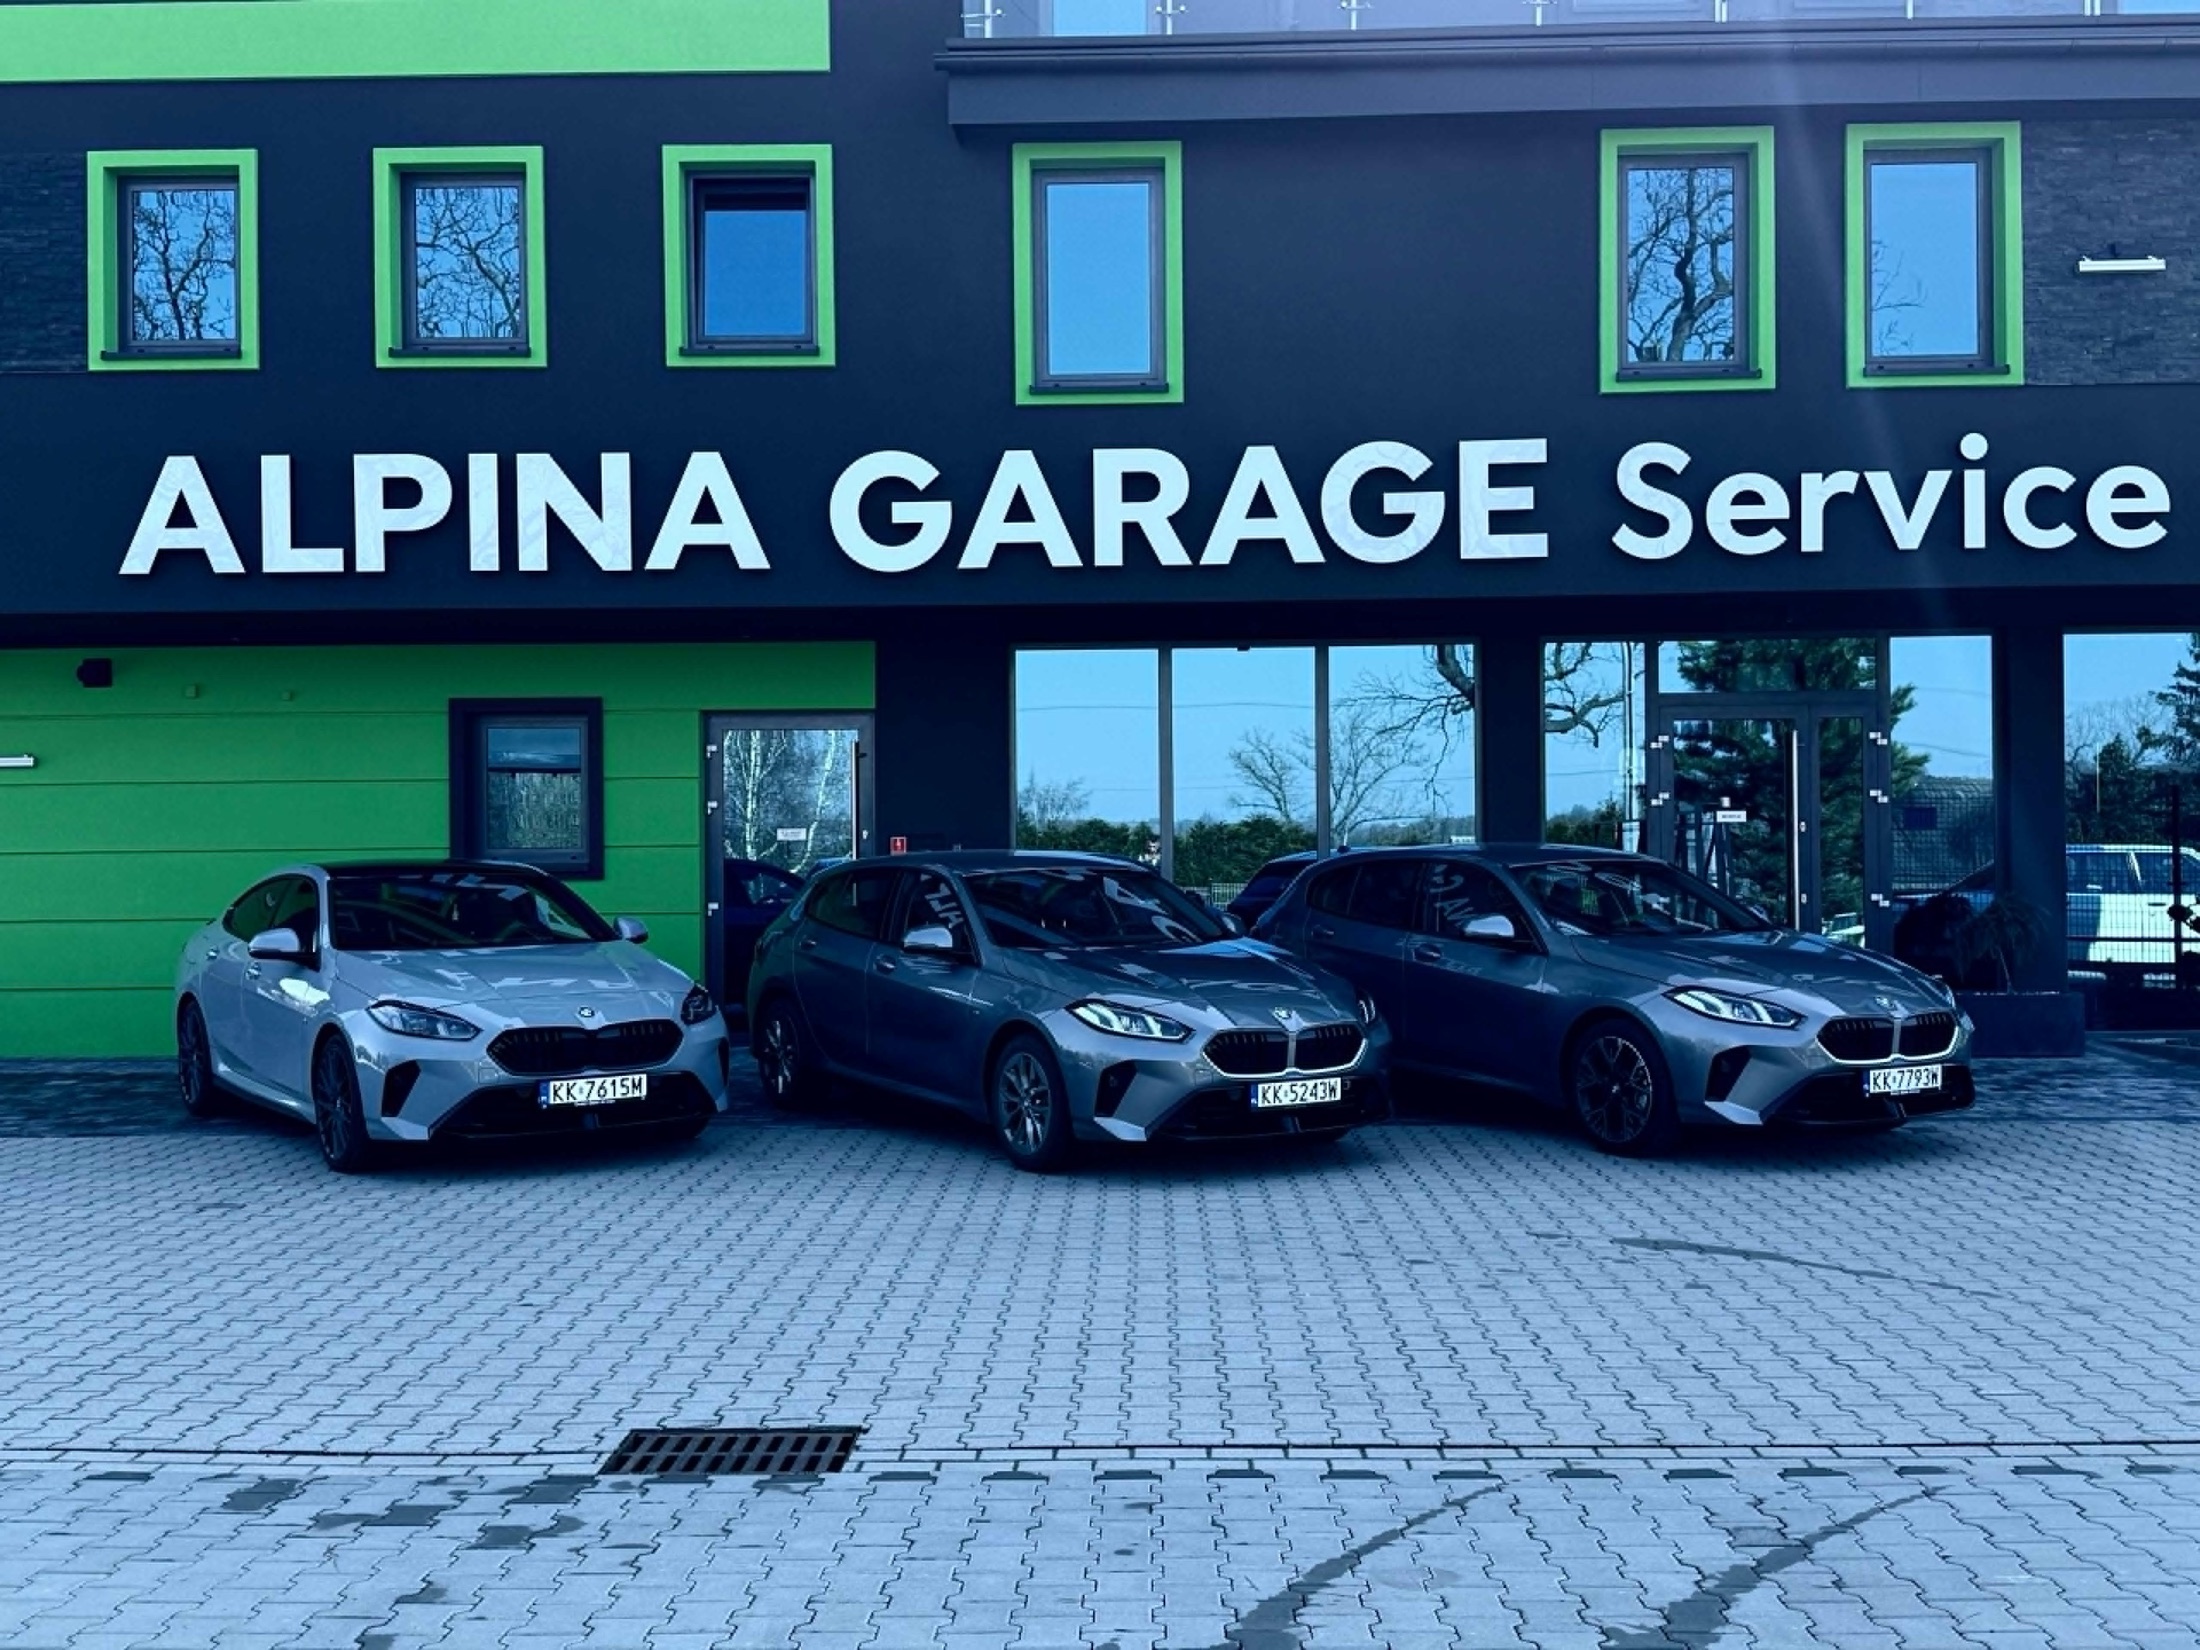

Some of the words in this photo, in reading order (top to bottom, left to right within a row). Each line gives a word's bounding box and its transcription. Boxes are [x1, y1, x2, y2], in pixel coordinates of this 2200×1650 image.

[119, 451, 771, 575] ALPINA
[829, 438, 1548, 572] GARAGE
[1612, 432, 2170, 559] Service
